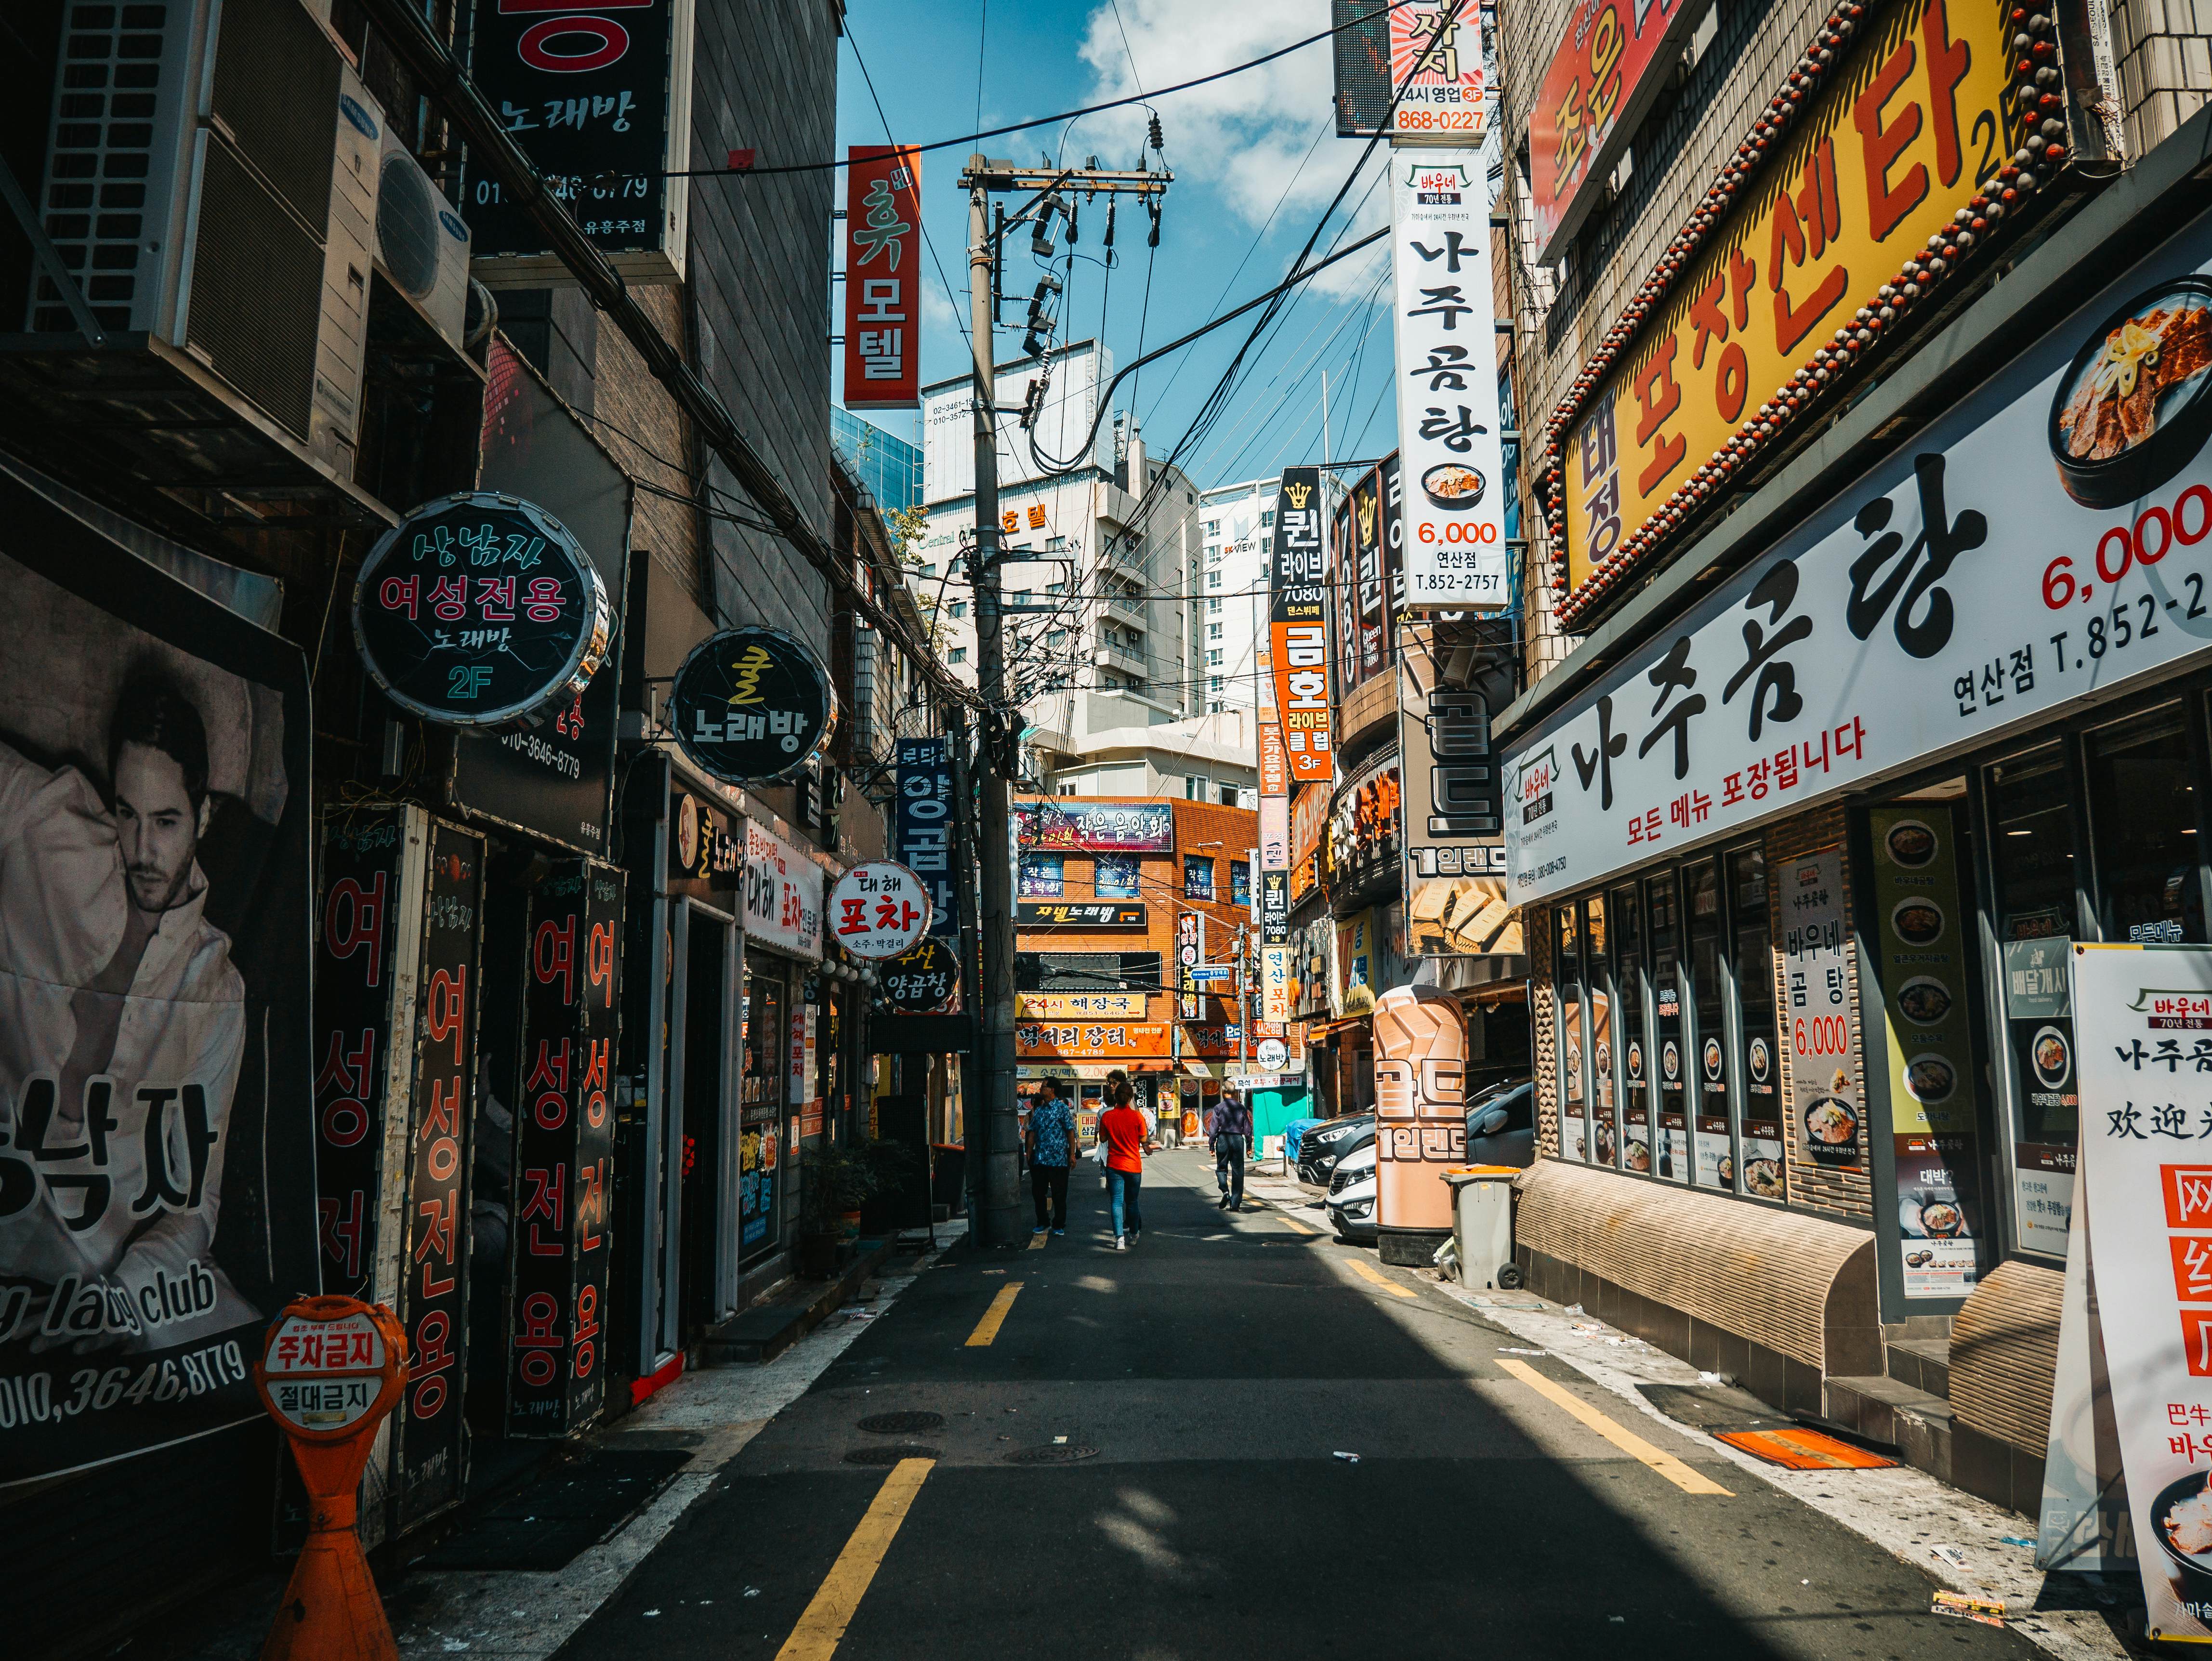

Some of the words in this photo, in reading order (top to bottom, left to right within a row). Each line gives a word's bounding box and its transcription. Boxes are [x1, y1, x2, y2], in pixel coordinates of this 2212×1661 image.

[1433, 86, 1461, 103] 영업
[1463, 89, 1481, 101] 3F
[339, 93, 378, 140] SAMSUNG
[501, 91, 636, 133] 노래방
[1398, 110, 1484, 130] 868-0227
[1421, 172, 1456, 194] 바우네
[1424, 195, 1439, 204] 70년
[1440, 194, 1452, 204] 전통
[584, 219, 646, 235] 유흥주점
[1633, 0, 1971, 499] 포장센타
[1970, 79, 2023, 191] 2F
[857, 278, 907, 380] 모텔
[1407, 231, 1488, 453] 나주곰탕
[1002, 504, 1046, 533] 호텔
[1282, 509, 1319, 548] 퀸
[1234, 541, 1256, 554] VIEW
[1418, 523, 1497, 545] 6,000
[2042, 484, 2212, 610] 6,000
[1281, 551, 1323, 582] 라이브
[1437, 551, 1476, 569] 연산점
[1282, 584, 1324, 603] 7080
[1415, 574, 1500, 591] T.852-2757
[380, 574, 567, 622] 여성전용
[1287, 606, 1320, 616] 댄스뷔페
[433, 627, 512, 652] 노래방
[1363, 625, 1381, 645] Queen
[1366, 640, 1377, 653] Live
[1570, 453, 1988, 811] 나주곰탕
[1287, 626, 1328, 709] 금호
[1954, 644, 2035, 717] 연산점
[447, 666, 493, 699] 2F
[693, 709, 809, 753] 노래방
[1288, 712, 1328, 729] 라이브
[502, 732, 580, 774] 010-3646-8779
[1298, 754, 1322, 770] 3F
[1427, 693, 1498, 831] 골드
[1525, 764, 1549, 802] 바우네
[1627, 806, 1663, 846] 모든
[1671, 789, 1712, 828] 메뉴
[1721, 715, 1866, 808] 포장됩니다
[1076, 813, 1107, 841] 작은
[1113, 812, 1163, 842] 음악회
[1527, 805, 1538, 822] 70년
[580, 821, 601, 840] 유흥주점
[749, 828, 778, 867] 종로빈대떡
[858, 875, 901, 893] 대해
[1027, 866, 1051, 878] 작은
[1188, 869, 1205, 881] 작은
[747, 862, 775, 922] 대해
[782, 882, 803, 933] 포차
[802, 907, 817, 937] 전문점
[1022, 880, 1061, 895] 음악회
[1265, 889, 1284, 910] 퀸
[838, 895, 921, 935] 포차
[1068, 906, 1115, 923] 노래방
[1181, 932, 1197, 946] 일광
[1265, 926, 1286, 935] 7080
[1788, 919, 1841, 962] 바우네
[2129, 920, 2183, 943] 모든메뉴
[1267, 951, 1286, 983] 연산
[2012, 966, 2067, 995] 배달개시
[887, 972, 947, 1001] 양곱창
[1024, 998, 1063, 1009] 24시
[1070, 997, 1131, 1010] 해장국
[1269, 988, 1288, 1017] 포차
[2155, 997, 2210, 1018] 바우네
[1018, 1026, 1080, 1048] 먹거리
[1084, 1026, 1126, 1047] 장터
[1795, 1014, 1847, 1060] 6,000
[2160, 1018, 2183, 1028] 70년
[2185, 1017, 2204, 1028] 전통
[1260, 1054, 1285, 1063] 노래방
[1376, 1059, 1466, 1118] 골드
[1917, 1110, 1950, 1121] 도가니탕
[514, 914, 576, 1386] 여성전용
[573, 920, 615, 1378] 여성전용
[408, 964, 466, 1420] 여성전용
[139, 1263, 216, 1326] club
[277, 1331, 374, 1370] 주차금지
[280, 1383, 368, 1412] 절대금지
[513, 1398, 560, 1419] 노래방
[407, 1447, 448, 1489] 노래방
